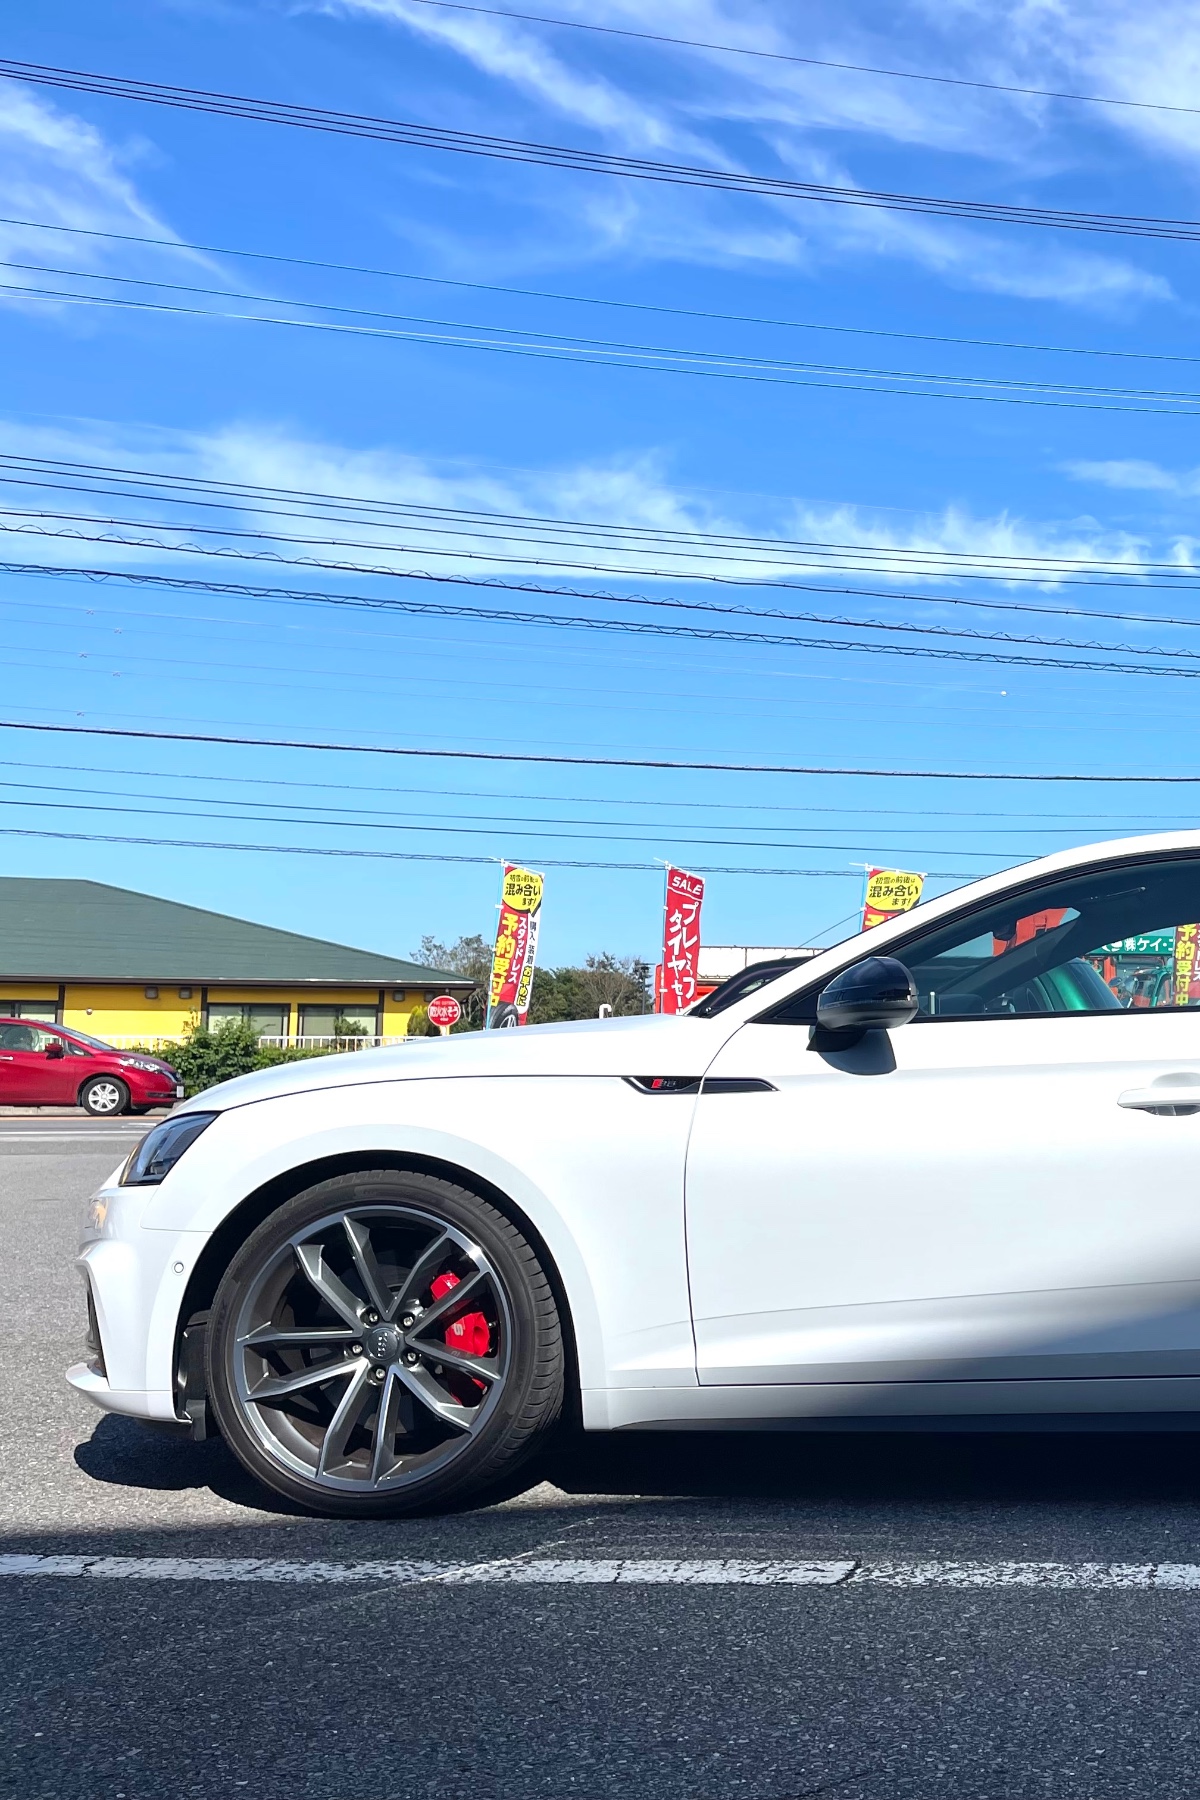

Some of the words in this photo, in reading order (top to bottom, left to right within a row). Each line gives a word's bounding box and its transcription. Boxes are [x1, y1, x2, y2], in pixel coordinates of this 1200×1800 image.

[505, 883, 541, 896] 混み合い
[672, 876, 703, 896] SALE
[868, 885, 919, 898] 混み合い
[508, 916, 528, 984] スタッドレス
[1175, 923, 1198, 1006] 予約受付中
